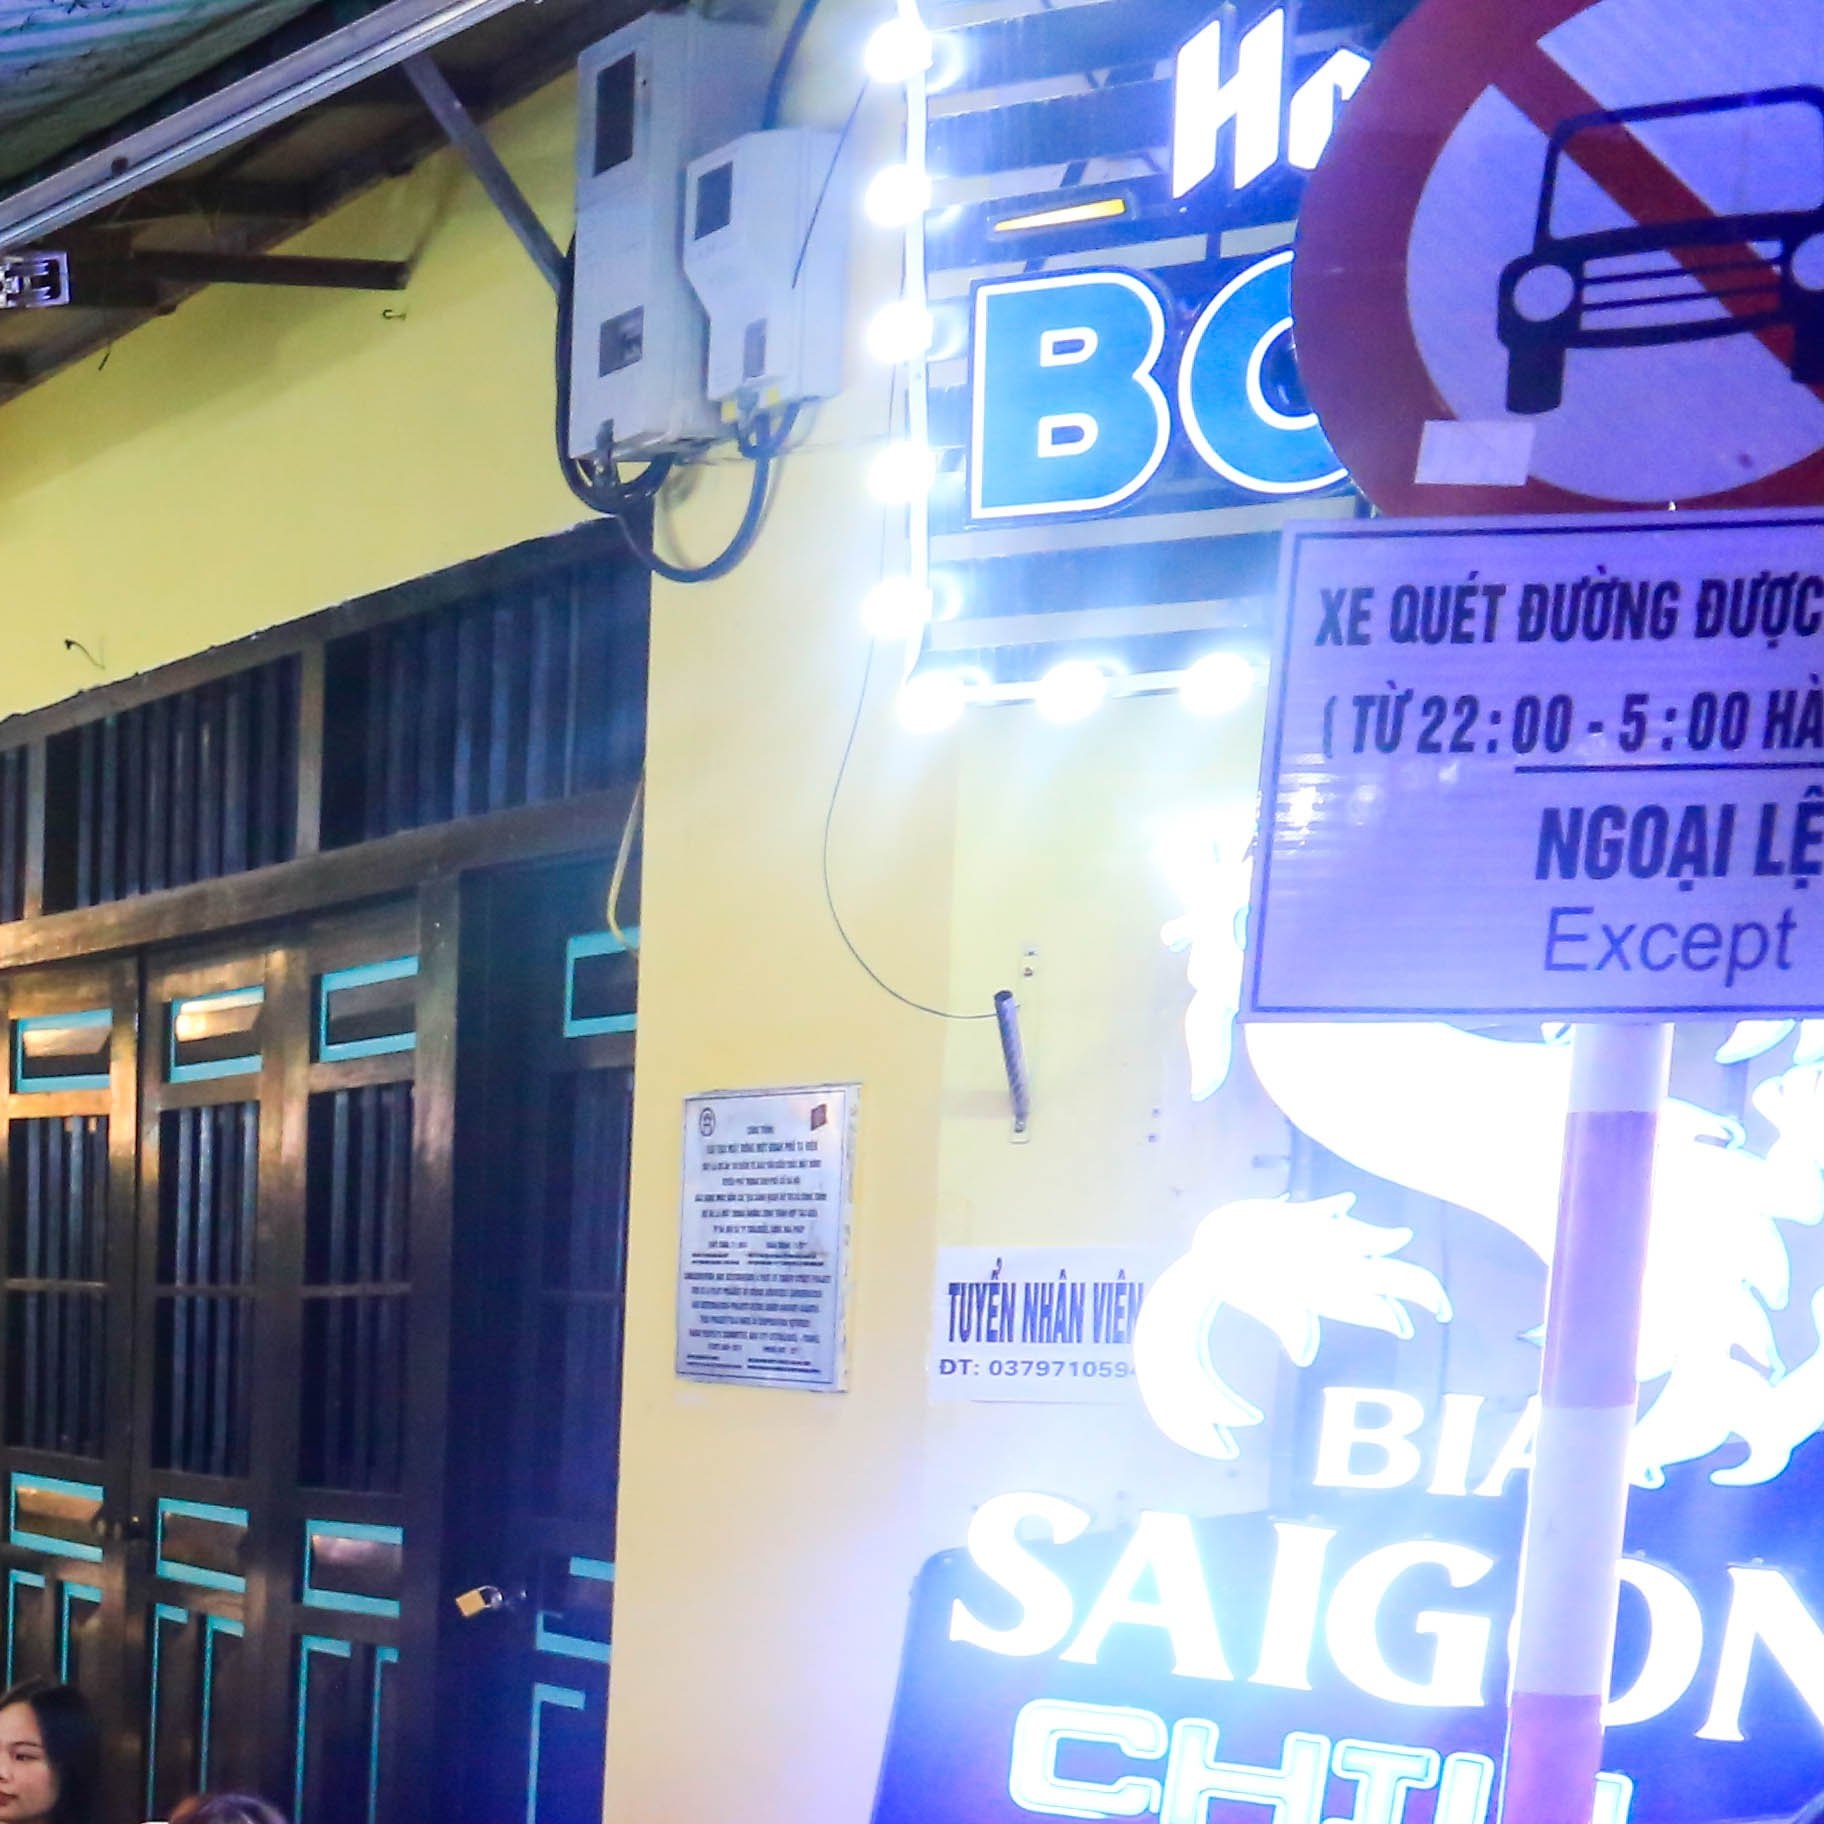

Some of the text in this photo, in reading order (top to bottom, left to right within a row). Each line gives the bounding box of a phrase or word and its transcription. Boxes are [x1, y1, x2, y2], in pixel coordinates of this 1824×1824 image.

[1315, 565, 1824, 648] XE QUÉT ĐƯỜNG ĐƯỢC
[1535, 804, 1737, 891] NGOẠI
[1544, 906, 1798, 988] Except
[948, 1257, 1145, 1344] TUYỂN NHÂN VIÊN
[940, 1358, 1136, 1378] ĐT: 037971059
